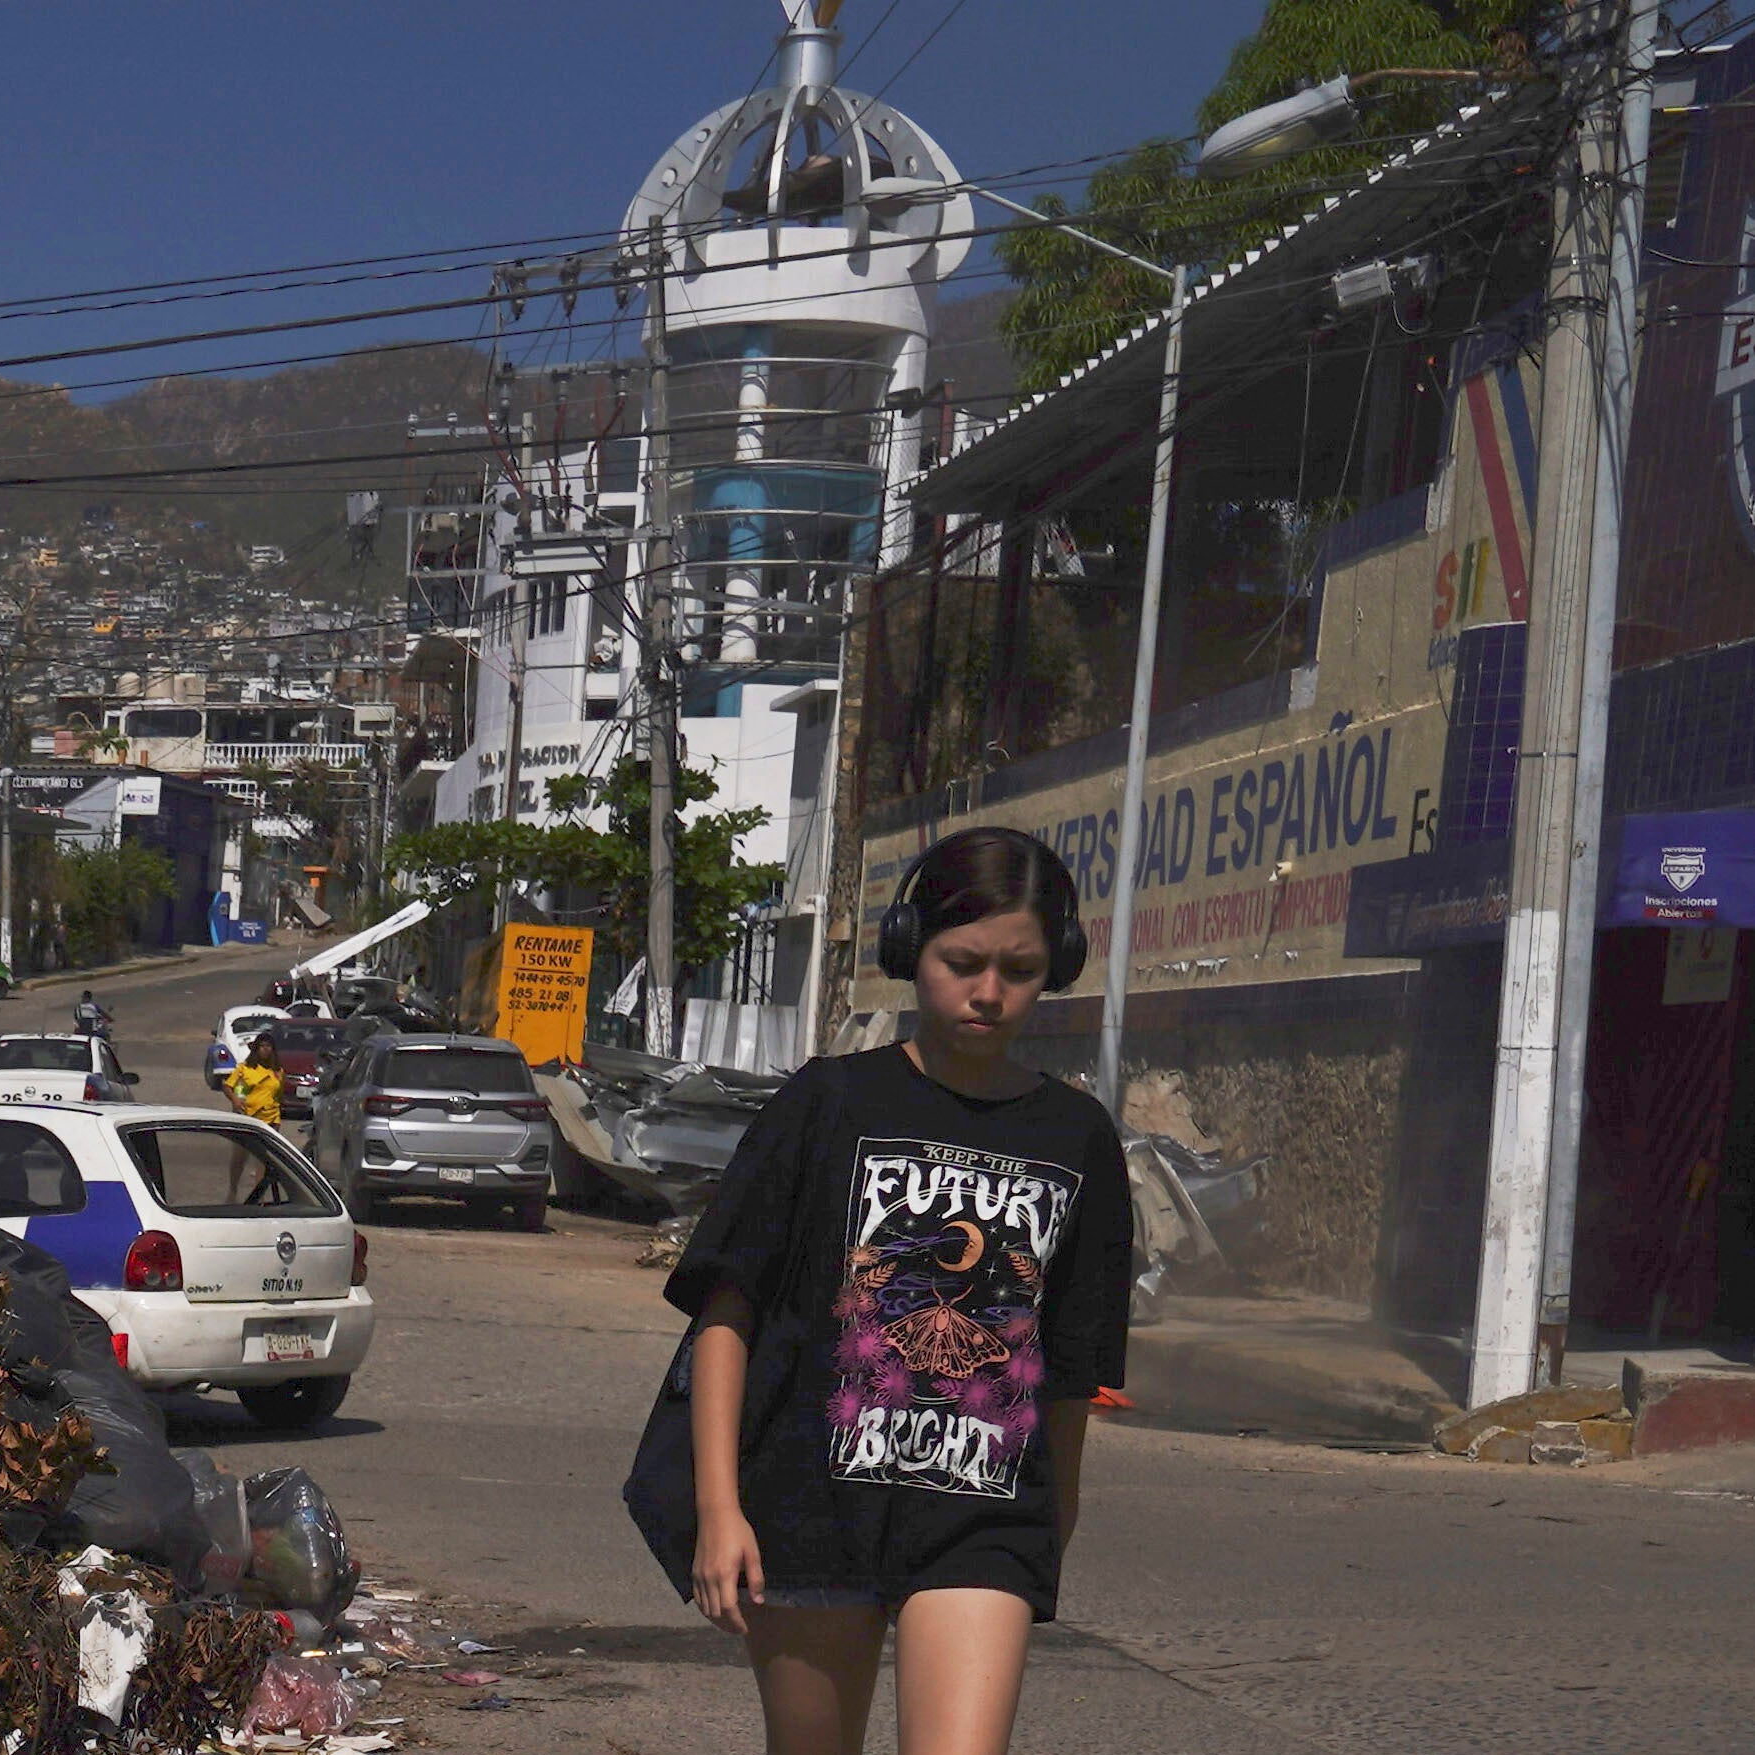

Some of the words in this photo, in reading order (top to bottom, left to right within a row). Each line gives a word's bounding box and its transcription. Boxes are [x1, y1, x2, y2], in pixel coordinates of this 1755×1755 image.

[1730, 318, 1755, 370] E
[1206, 710, 1398, 876] ESPAÑOL
[514, 935, 584, 954] RENTAME
[1172, 903, 1199, 949] CON
[549, 955, 572, 968] KW
[923, 1144, 979, 1166] KEEP
[984, 1155, 1027, 1174] THE
[262, 1278, 284, 1292] SITIO
[845, 1405, 1005, 1490] BRIGHT
